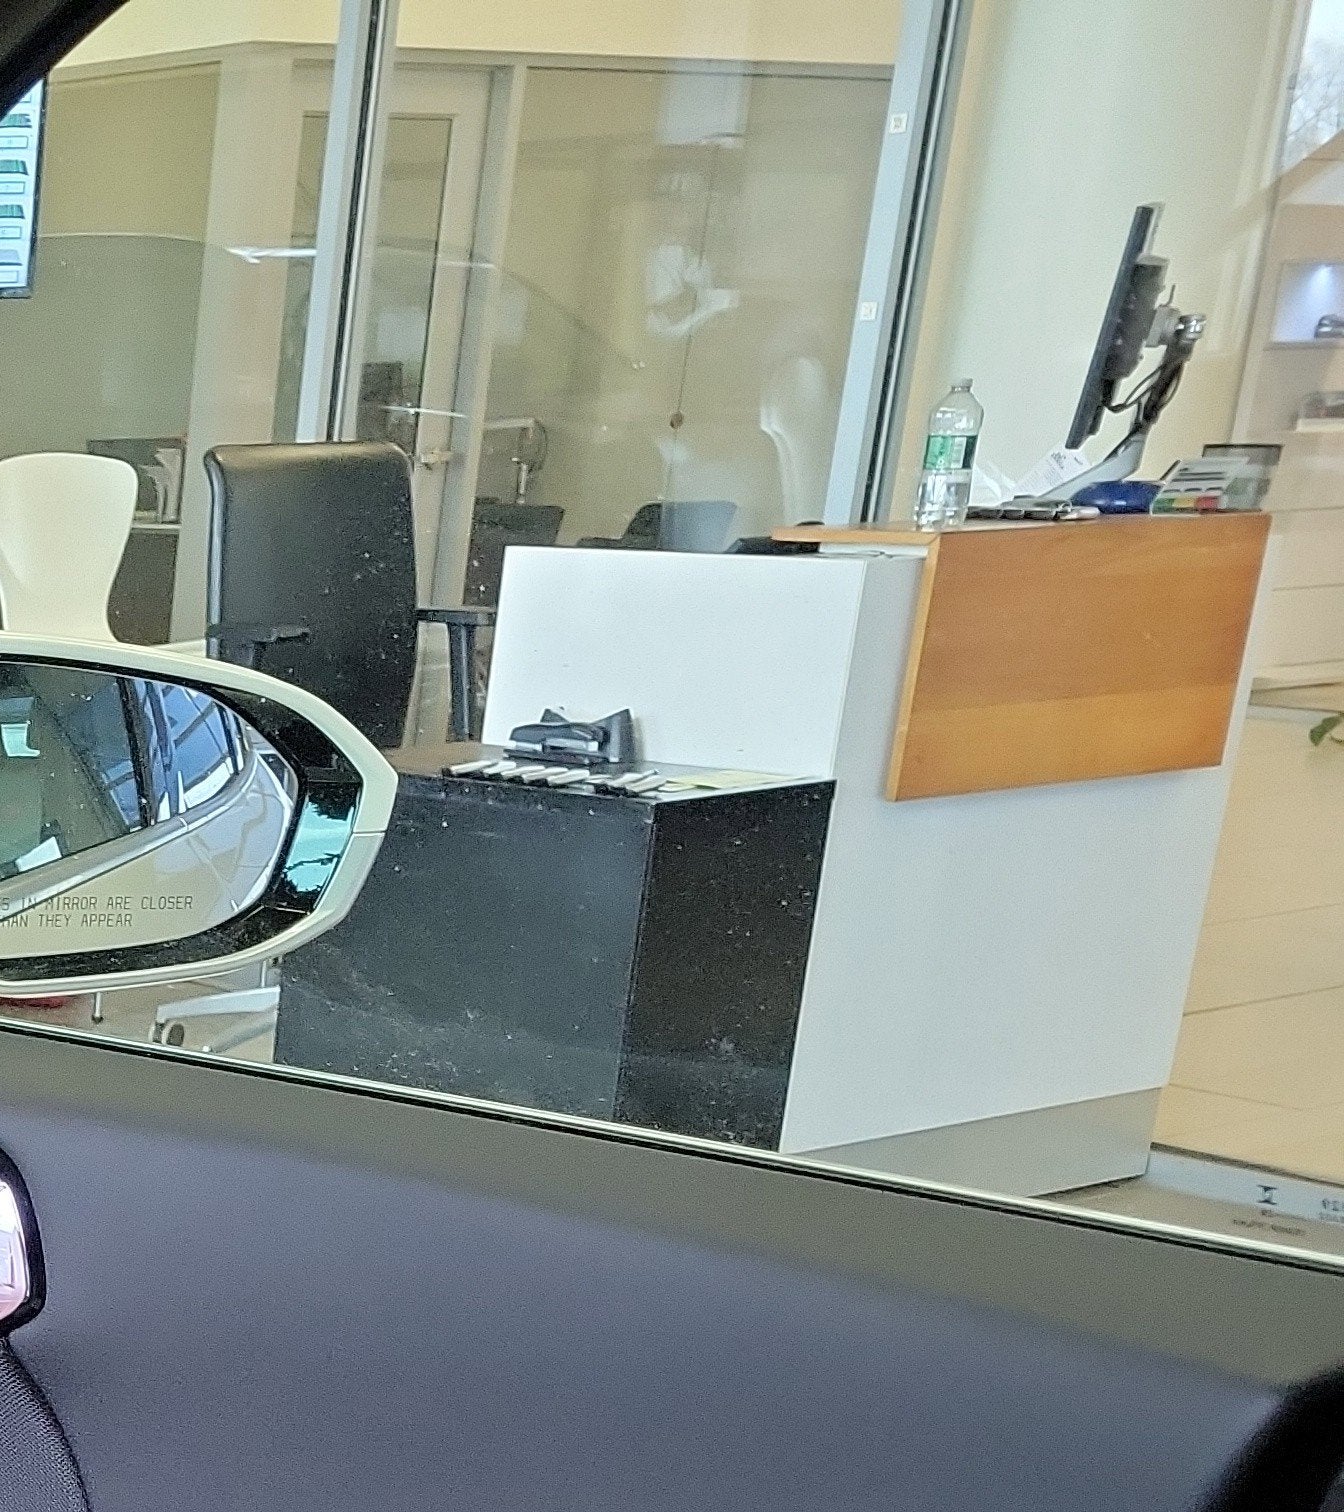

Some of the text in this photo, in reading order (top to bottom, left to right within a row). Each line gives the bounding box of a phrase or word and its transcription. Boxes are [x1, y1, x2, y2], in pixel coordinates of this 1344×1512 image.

[22, 897, 36, 910] IN
[45, 896, 98, 910] MIRROR
[106, 896, 131, 910] ARE
[140, 896, 193, 910] CLOSER
[38, 914, 71, 928] THEY
[81, 913, 132, 928] APPEAR
